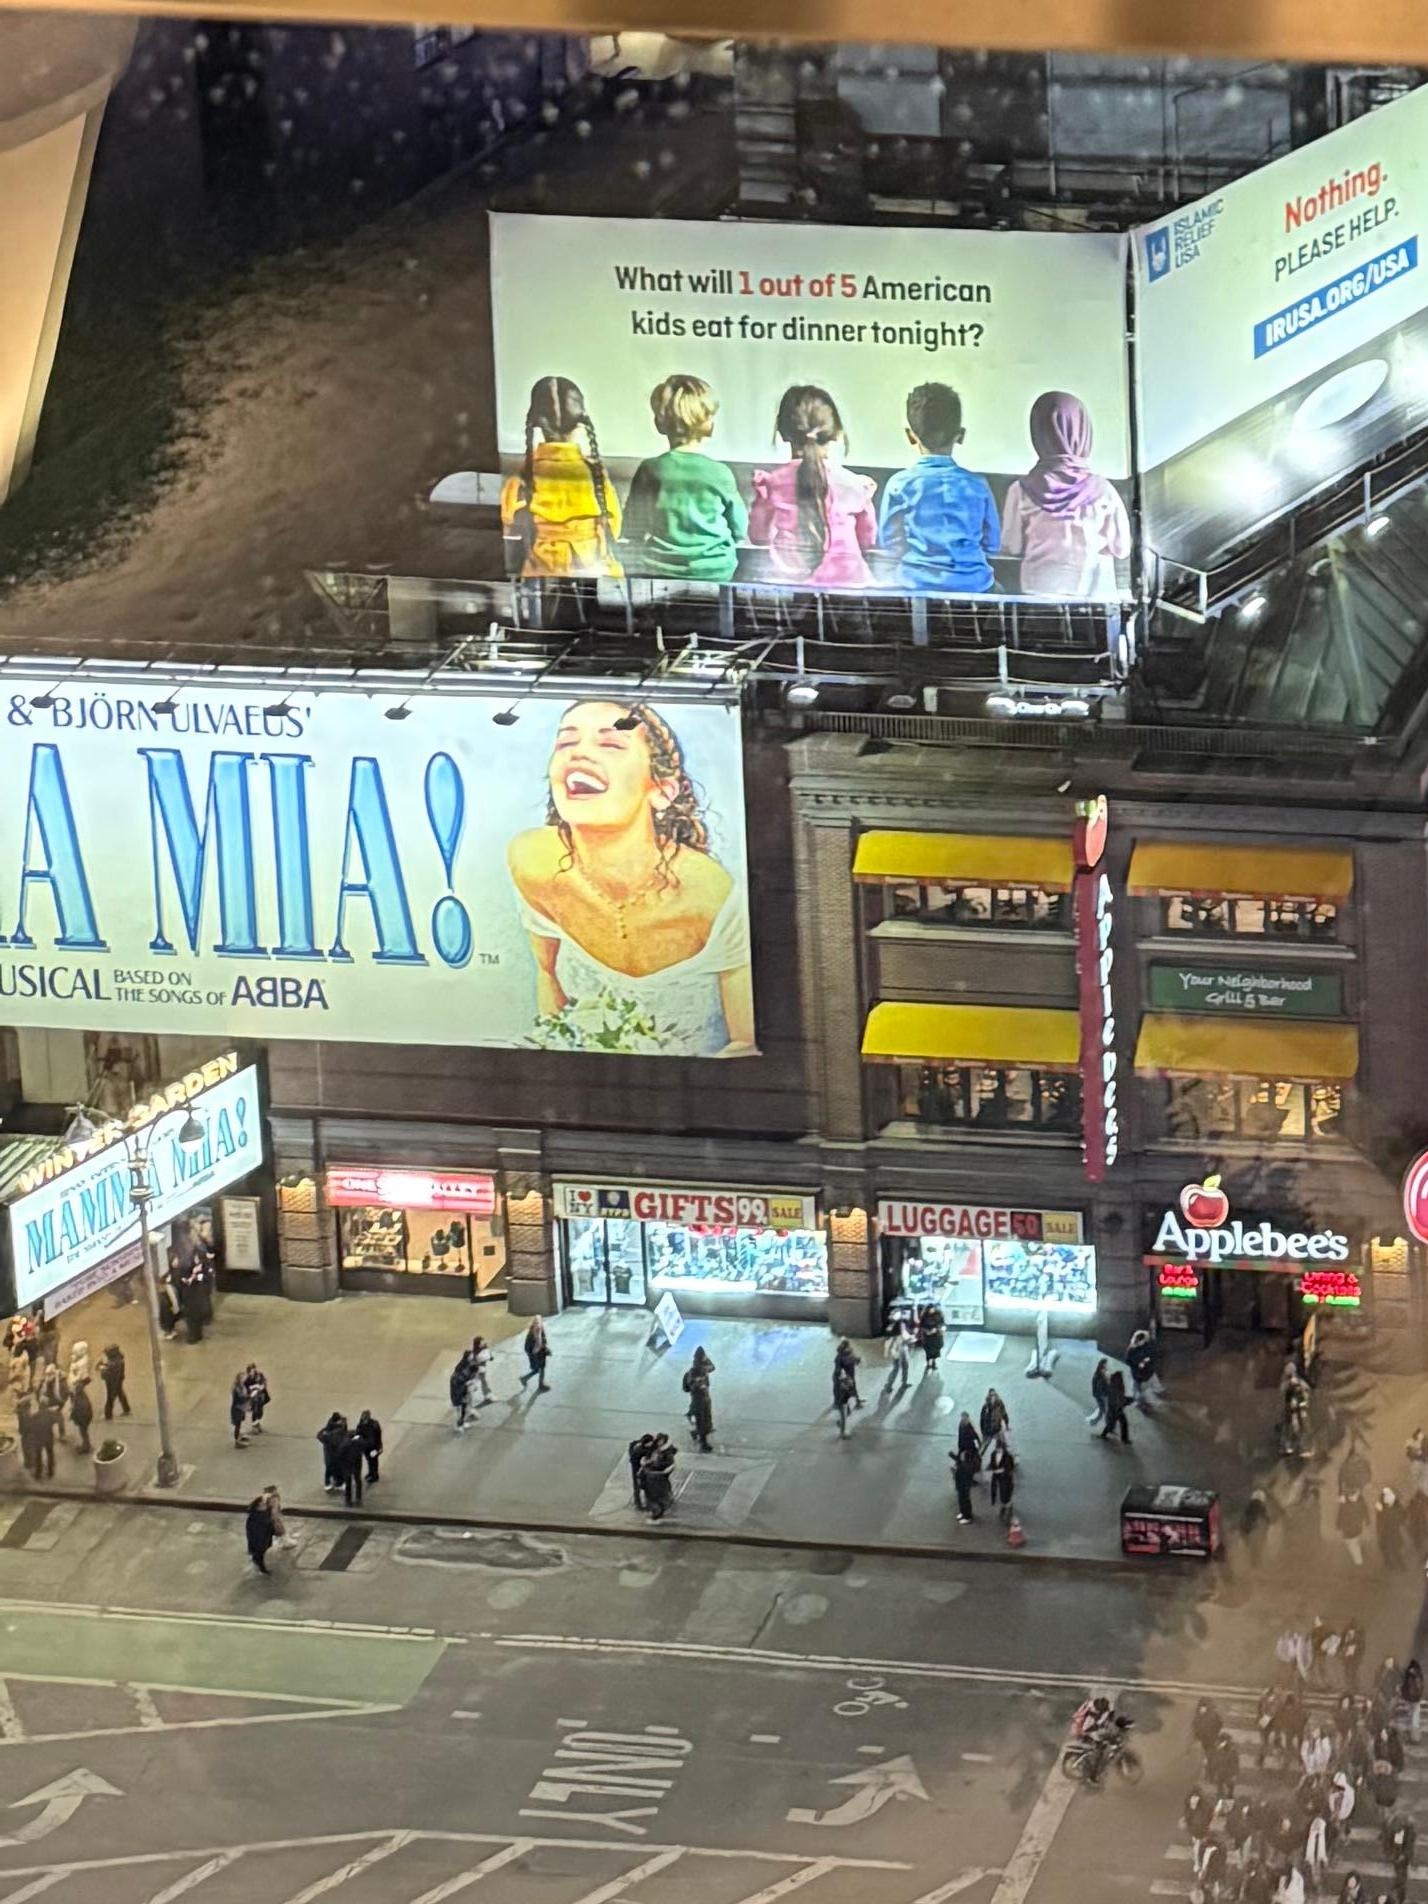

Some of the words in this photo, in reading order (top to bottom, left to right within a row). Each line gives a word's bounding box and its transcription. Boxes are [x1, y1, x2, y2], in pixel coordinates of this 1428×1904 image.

[1285, 161, 1388, 233] Nothing.
[1173, 198, 1225, 235] ISLAMIC
[1174, 221, 1215, 251] RELIEF
[1274, 224, 1345, 282] PLEASE
[1349, 197, 1400, 242] HELP.
[1175, 245, 1201, 269] USA
[615, 265, 683, 293] What
[690, 270, 733, 295] will
[738, 271, 754, 296] 1
[759, 274, 803, 298] out
[809, 273, 836, 298] of
[840, 273, 857, 298] 5
[862, 275, 992, 304] American
[1265, 248, 1410, 347] IRUSA.ORG/USA
[631, 310, 686, 337] kids
[692, 316, 734, 339] eat
[737, 314, 778, 341] for
[782, 316, 875, 343] dinner
[873, 319, 984, 352] tonight?
[7, 694, 34, 727] &
[52, 693, 159, 732] BJÖRN
[137, 746, 474, 970] MIA!
[113, 968, 164, 985] BASED
[167, 970, 192, 987] ON
[115, 986, 147, 1003] THE
[148, 988, 203, 1005] SONGS
[206, 991, 228, 1006] OF
[231, 975, 330, 1011] ABBA
[1178, 972, 1215, 991] Your
[1217, 974, 1314, 993] Neighborhood
[1204, 990, 1243, 1006] Grill
[1257, 993, 1287, 1007] Bar
[634, 1191, 735, 1225] GIFTS
[771, 1206, 801, 1220] SALE
[886, 1205, 1009, 1238] LUGGAGE
[1151, 1210, 1350, 1264] Applebee's
[517, 1731, 694, 1836] ONLY
